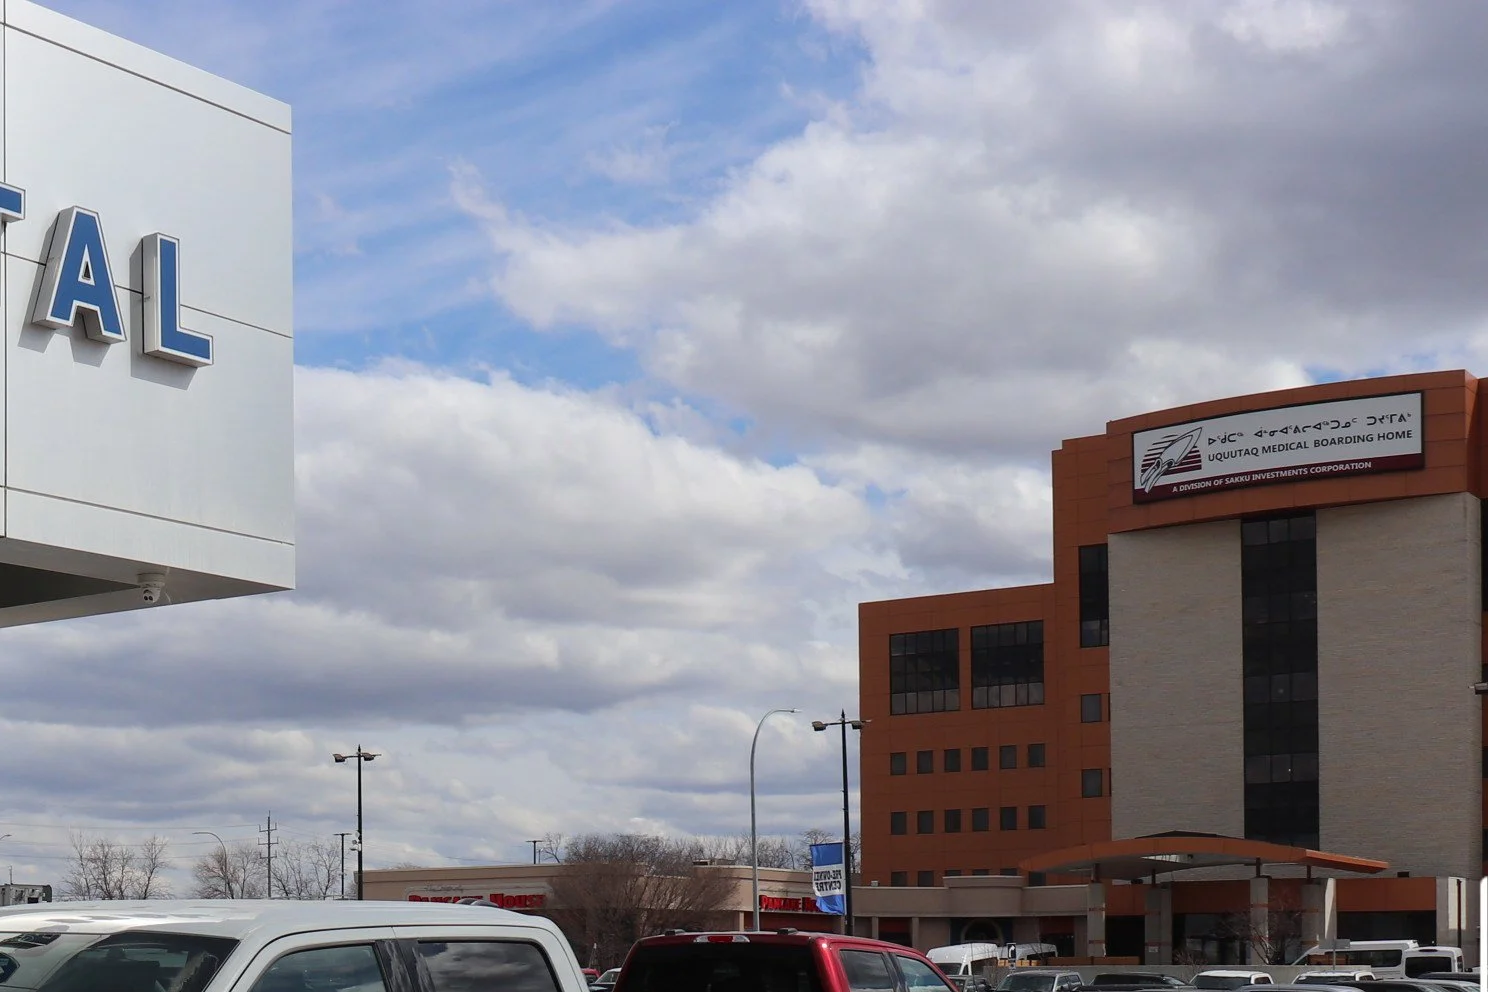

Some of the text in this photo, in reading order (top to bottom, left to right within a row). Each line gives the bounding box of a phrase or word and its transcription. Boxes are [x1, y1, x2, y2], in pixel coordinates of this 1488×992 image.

[1208, 430, 1413, 462] UQUUTAQ MEDICAL BOARDING HOME
[1179, 481, 1212, 492] DIVISION
[1225, 474, 1252, 485] SAKKU
[1252, 467, 1308, 482] INVESTMENTS
[1310, 461, 1372, 475] CORPORATION
